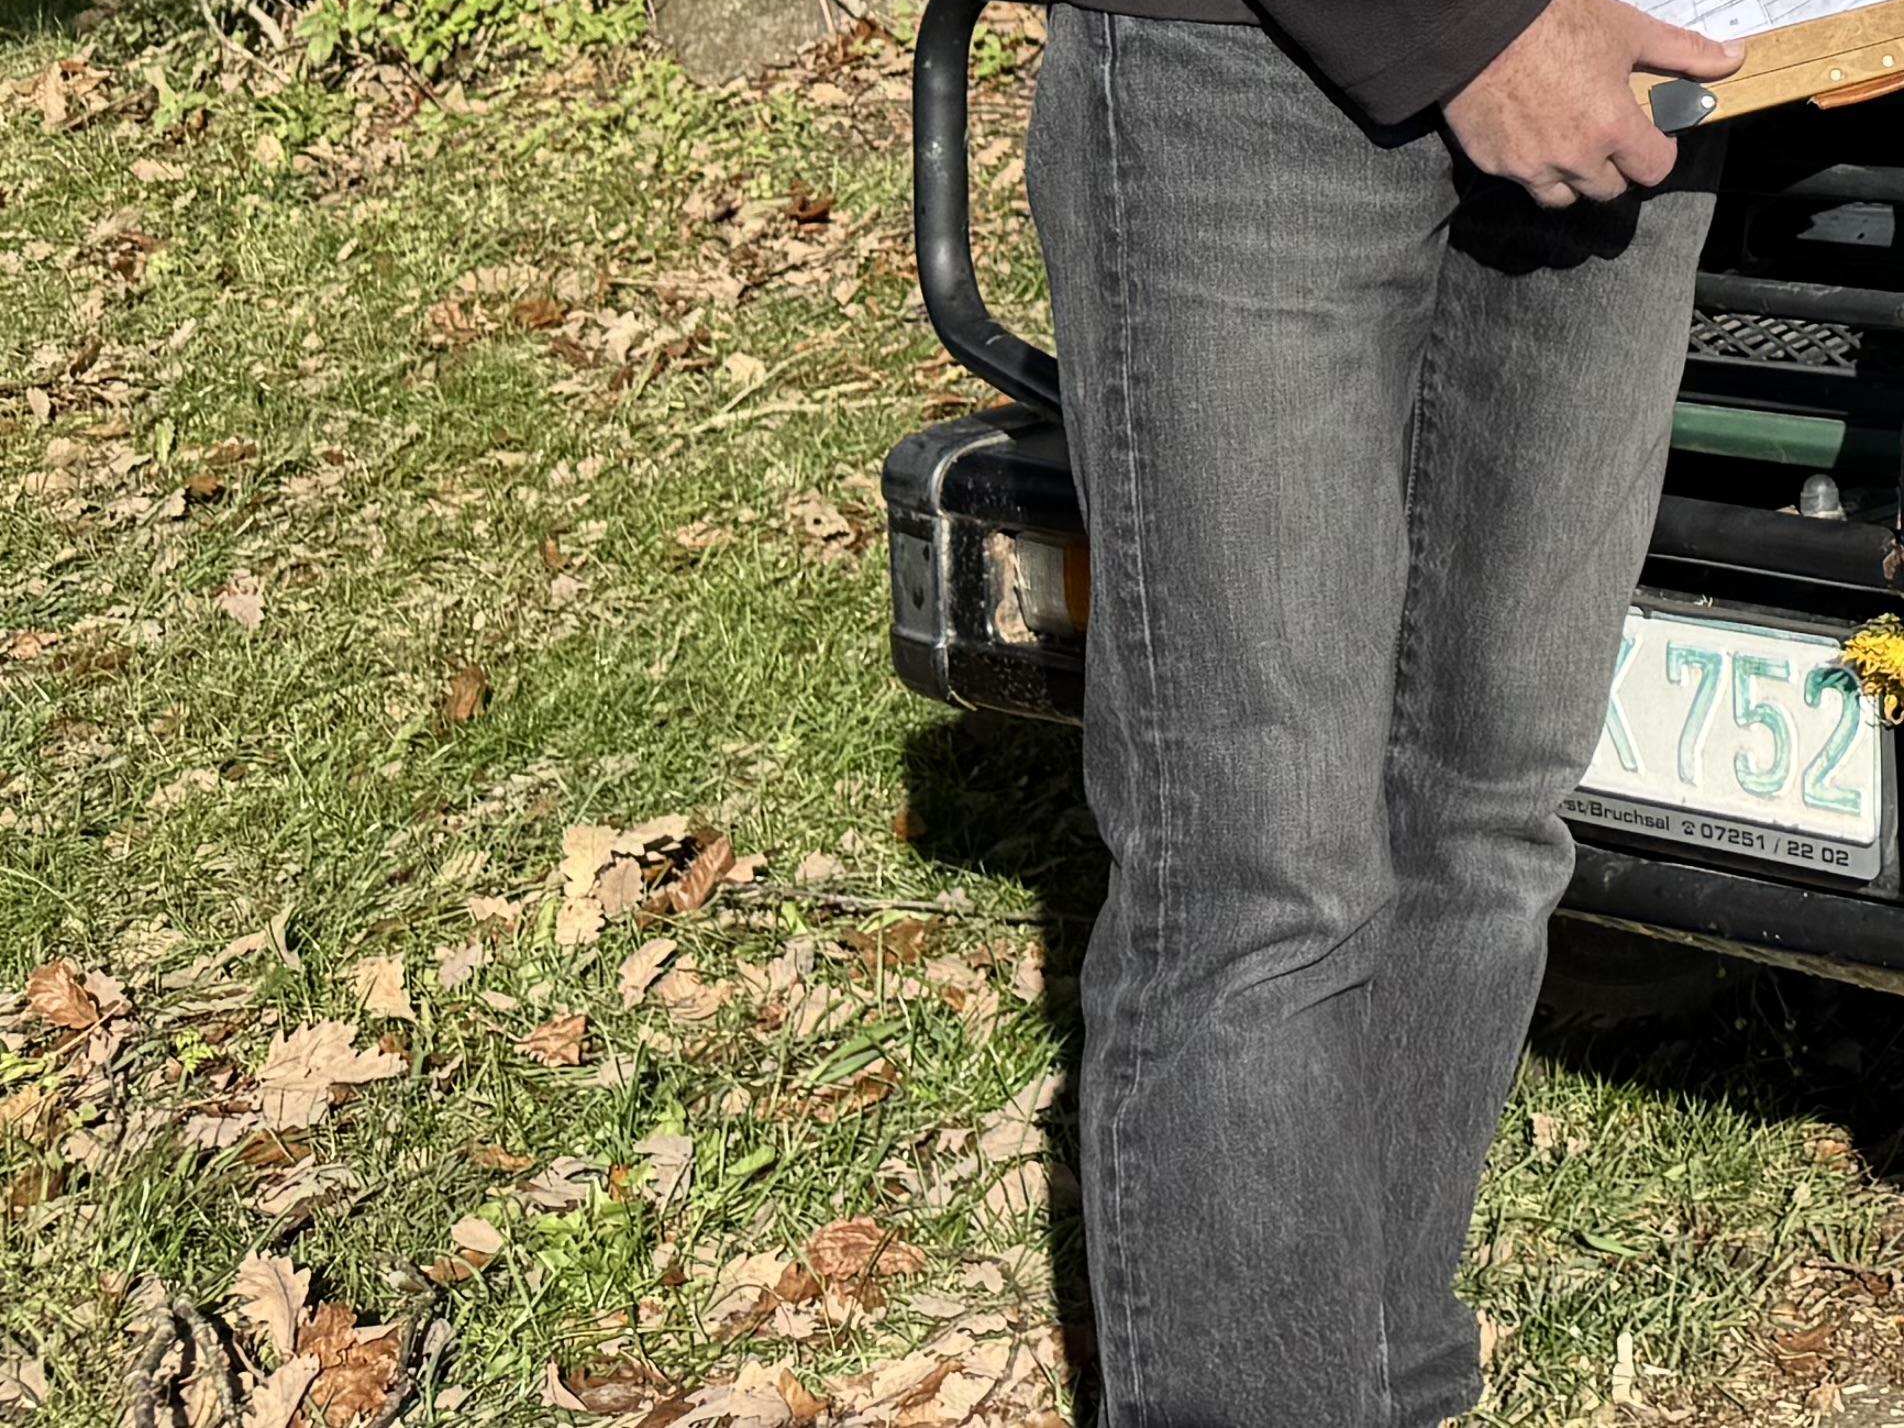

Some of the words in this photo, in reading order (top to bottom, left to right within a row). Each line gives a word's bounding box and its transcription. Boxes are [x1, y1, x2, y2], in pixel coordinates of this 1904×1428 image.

[1665, 640, 1864, 815] 752
[1700, 823, 1766, 850] 07251
[1773, 838, 1781, 855] /
[1786, 841, 1815, 859] 22
[1821, 847, 1850, 867] 02
